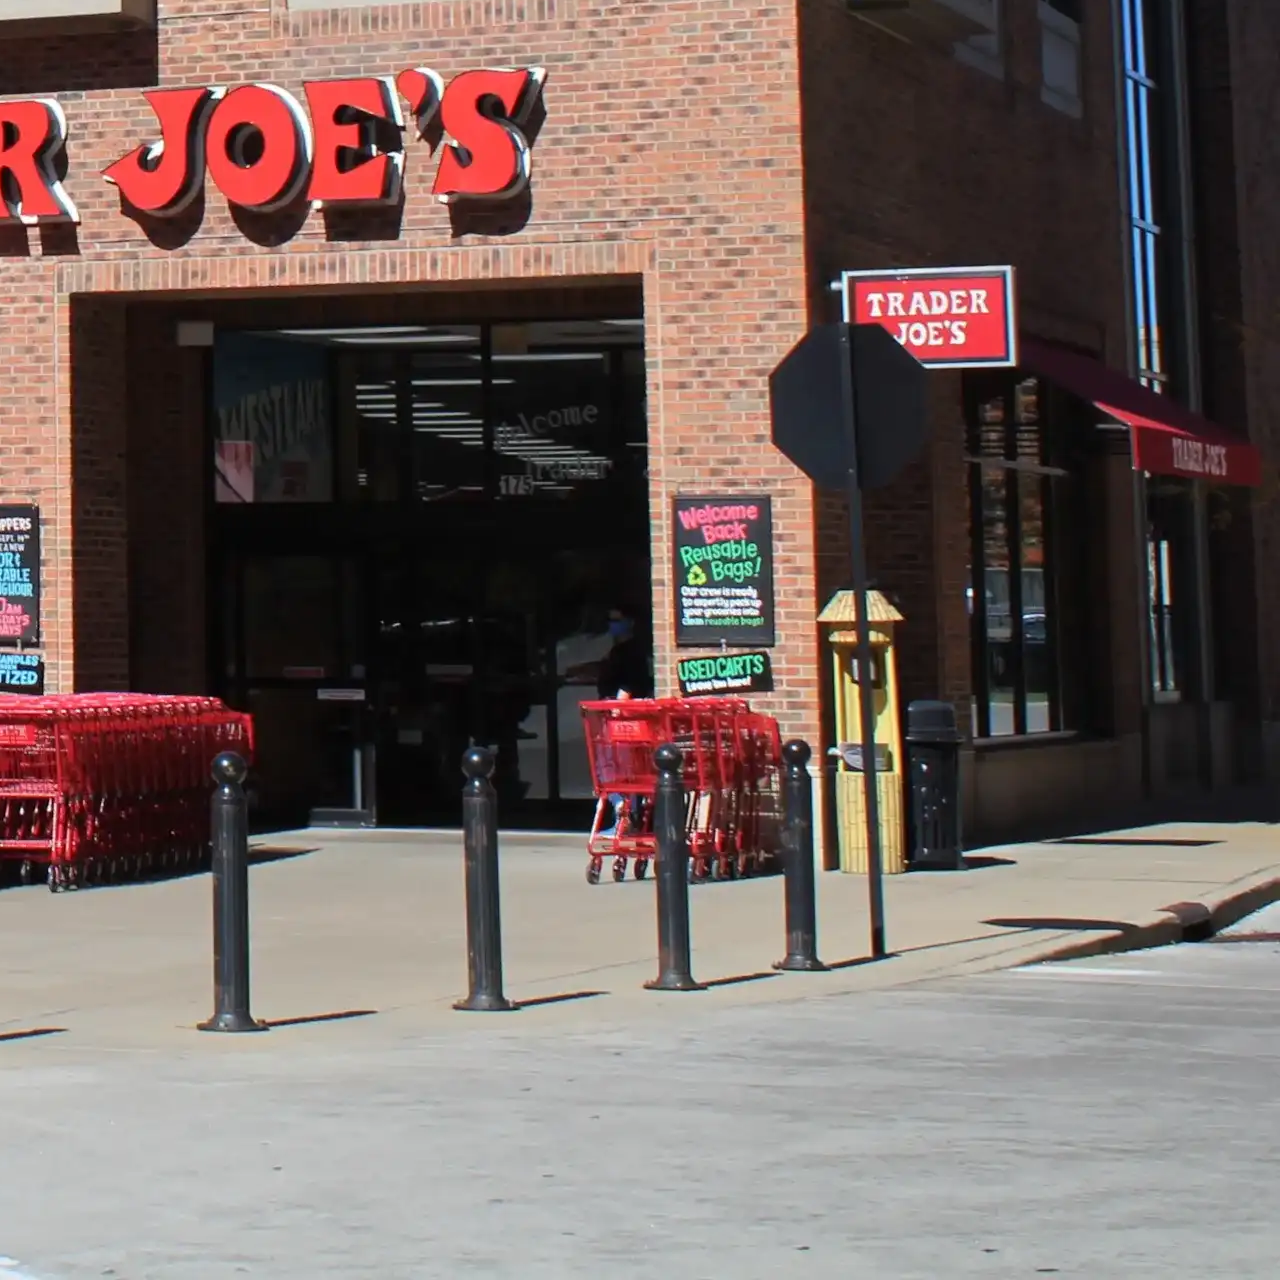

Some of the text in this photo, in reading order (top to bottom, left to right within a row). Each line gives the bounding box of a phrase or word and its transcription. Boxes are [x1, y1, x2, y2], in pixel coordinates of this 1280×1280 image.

[101, 66, 545, 222] JOE'S
[866, 289, 990, 317] TRADER
[893, 320, 967, 346] JOE'S
[1172, 436, 1228, 476] TRADER JOE'S
[678, 505, 758, 530] Welcome
[702, 524, 748, 544] Back
[680, 541, 758, 567] Reusable
[711, 558, 762, 583] Bags!
[677, 655, 764, 681] USED CARTS
